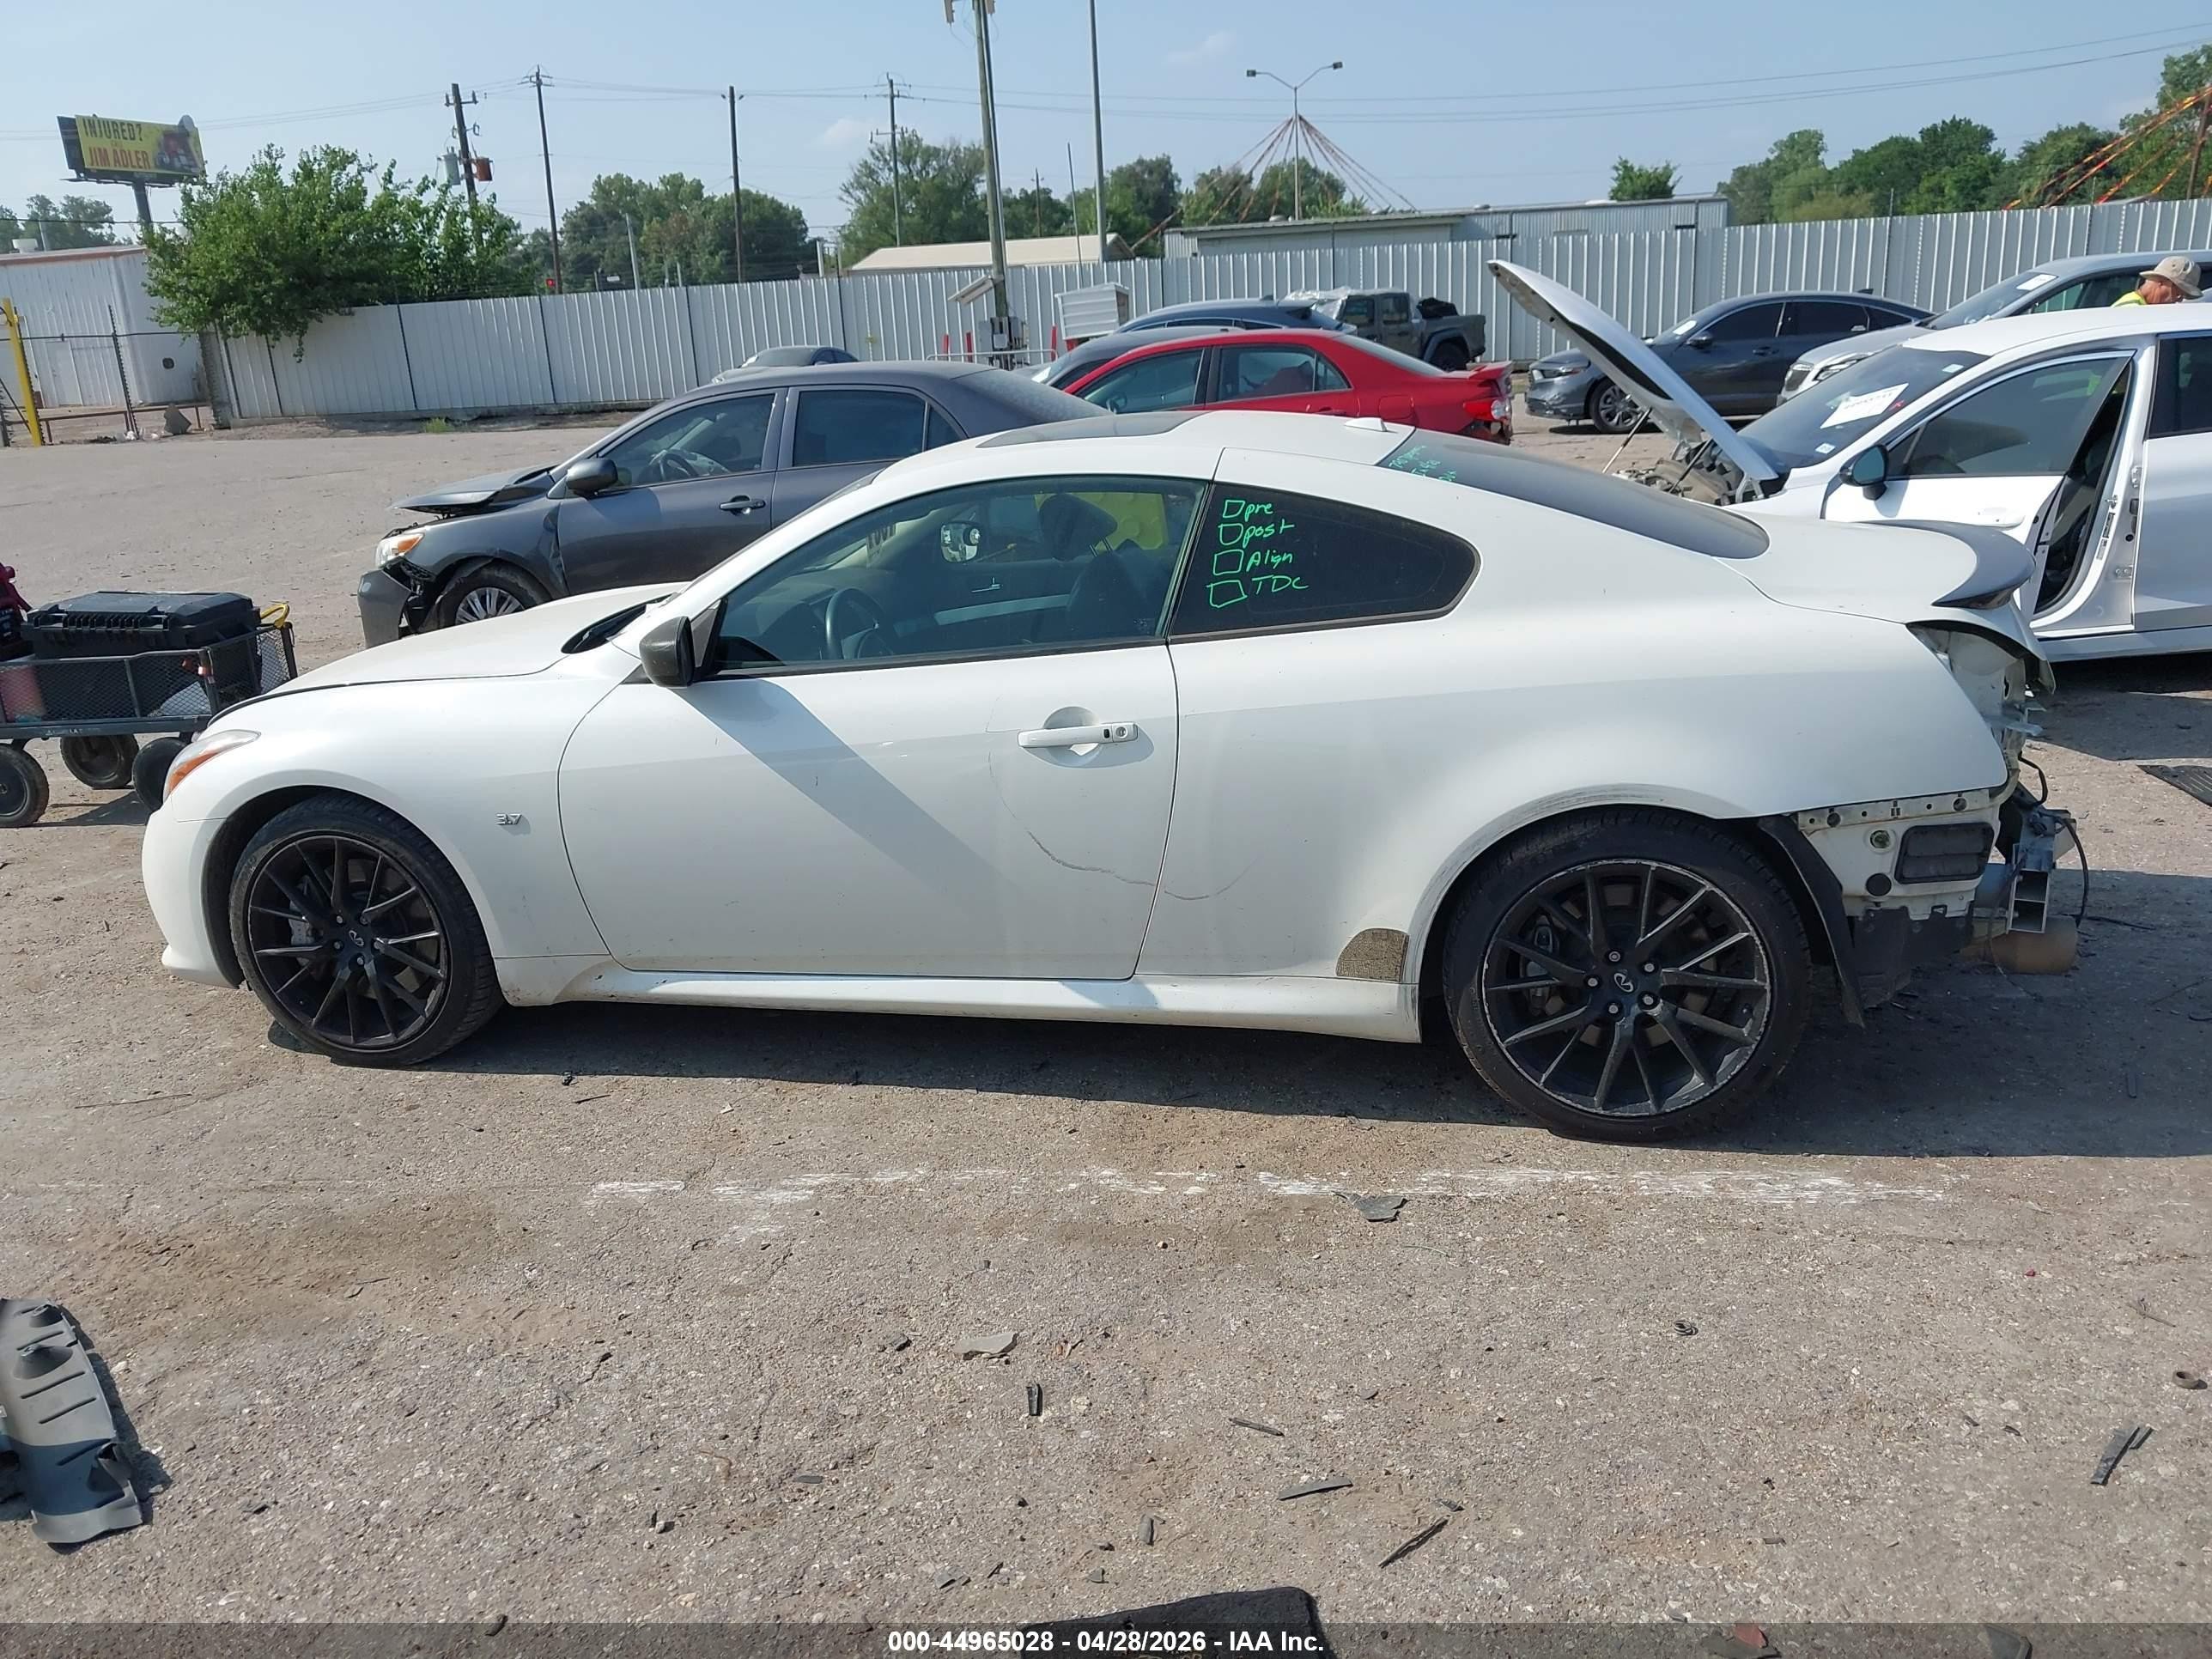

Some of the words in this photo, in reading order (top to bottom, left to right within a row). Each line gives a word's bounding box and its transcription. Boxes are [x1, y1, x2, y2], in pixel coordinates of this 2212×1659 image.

[82, 118, 143, 142] INJURED?
[88, 147, 111, 167] JIM
[112, 149, 151, 170] ADLER
[1244, 503, 1273, 522] pre
[1242, 519, 1295, 549] post
[1246, 550, 1293, 572] Align
[1251, 574, 1309, 595] TDC
